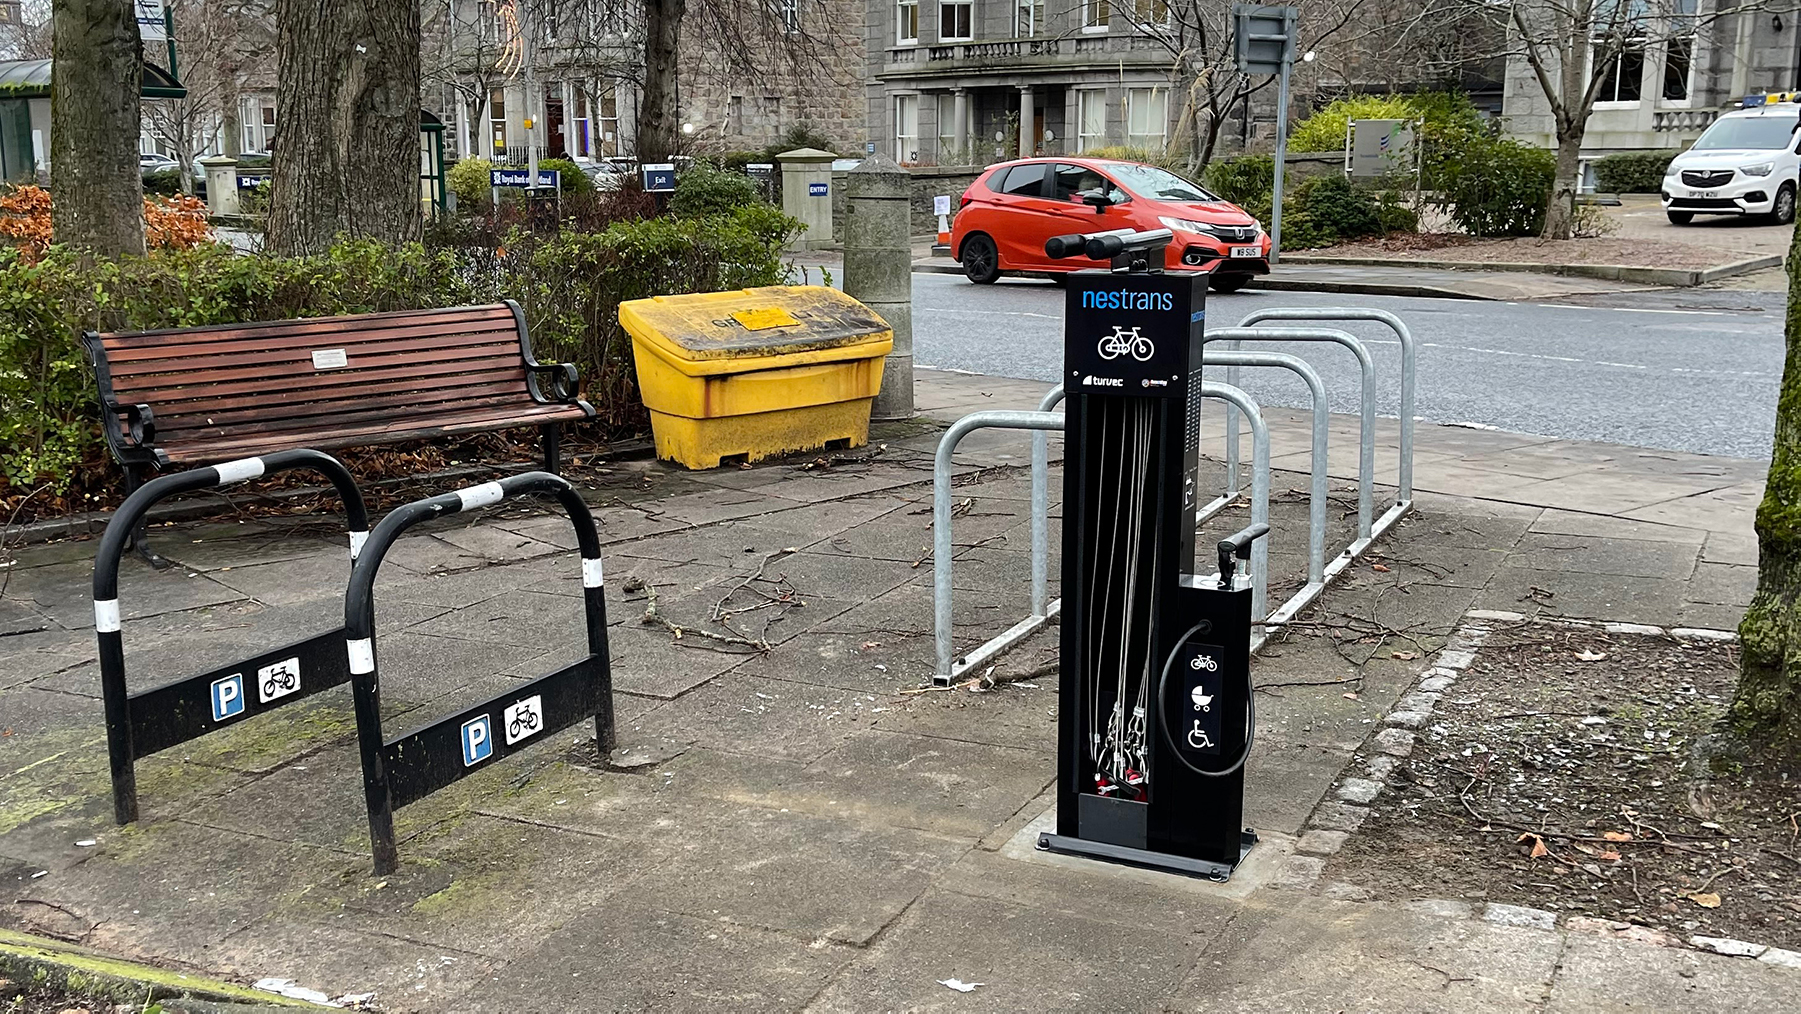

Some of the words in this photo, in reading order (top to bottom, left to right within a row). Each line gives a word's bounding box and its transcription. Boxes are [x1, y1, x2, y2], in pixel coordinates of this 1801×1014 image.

[501, 175, 514, 185] Royal
[514, 175, 526, 184] Bank
[655, 176, 667, 184] Exit
[809, 186, 828, 194] ENTRY
[1082, 288, 1173, 311] nestrans
[1092, 376, 1124, 387] turvec
[218, 680, 239, 716] P
[467, 721, 488, 760] P
